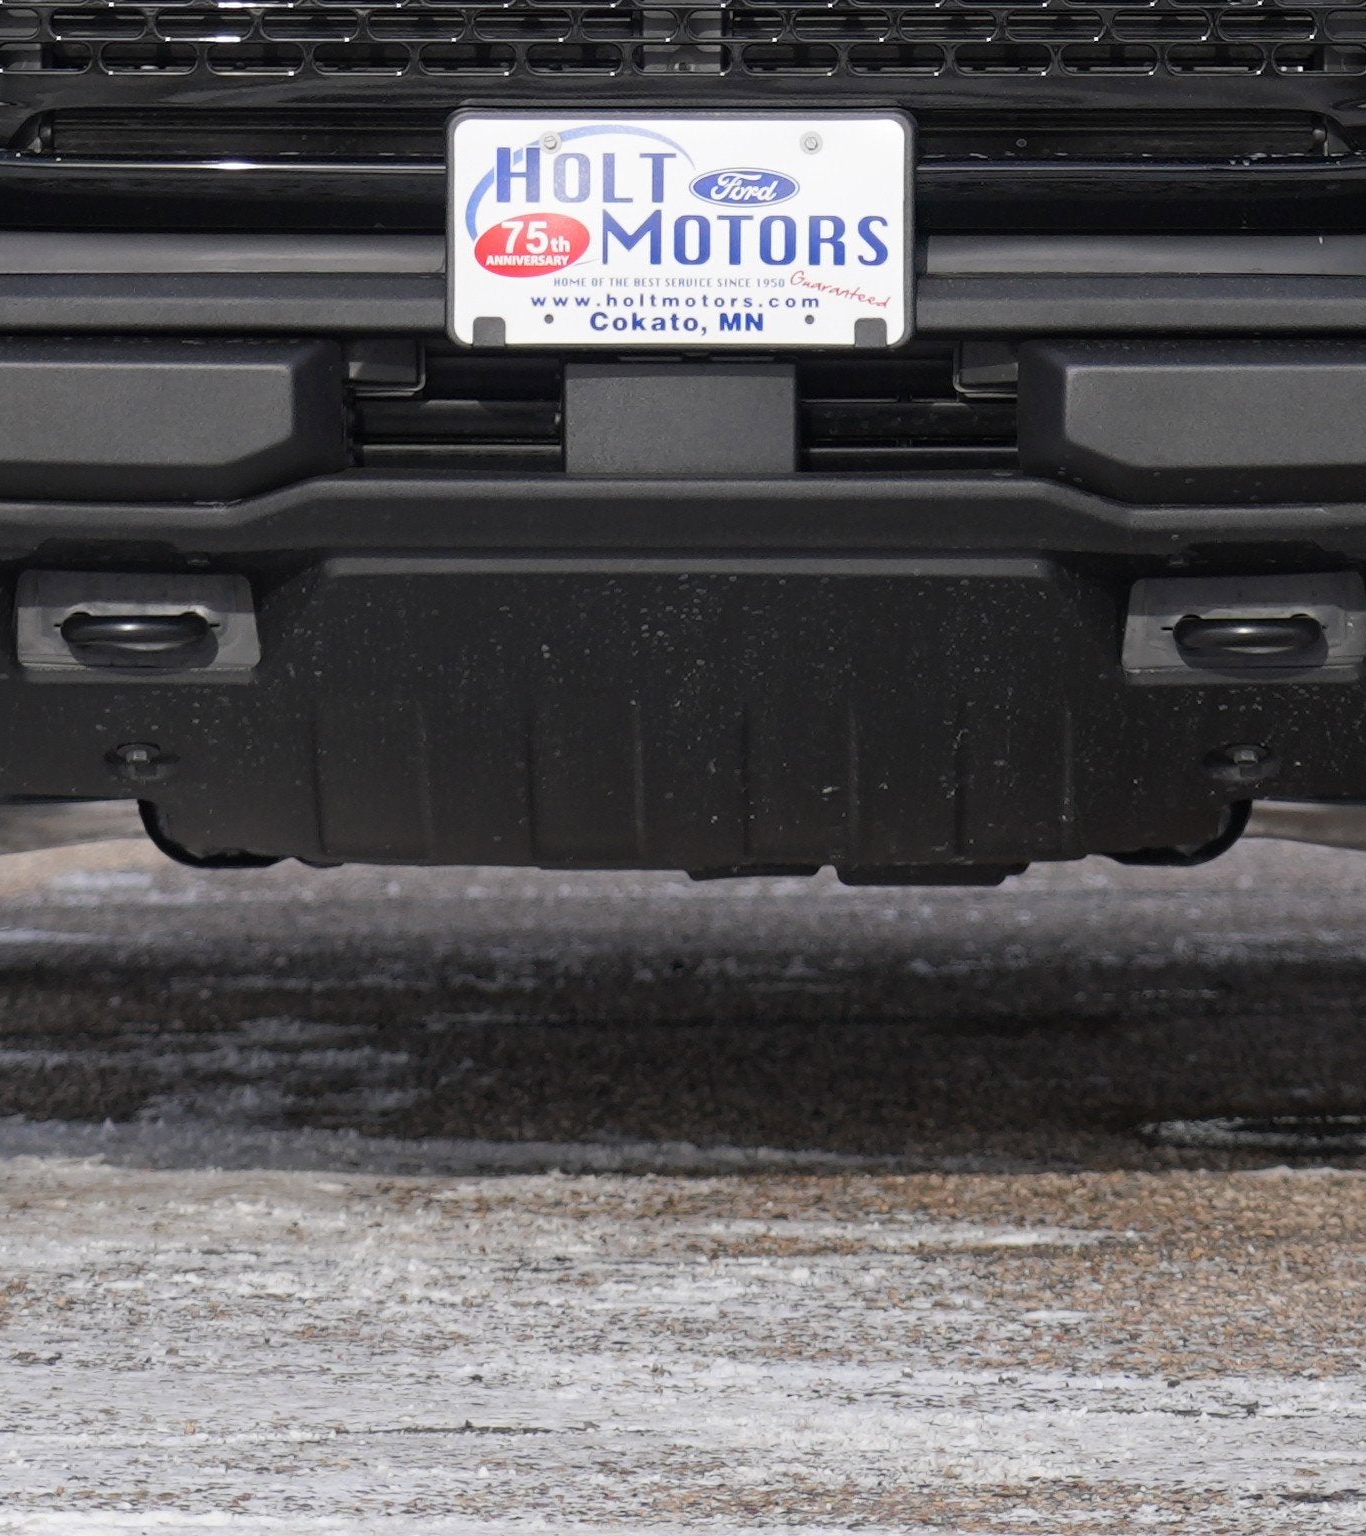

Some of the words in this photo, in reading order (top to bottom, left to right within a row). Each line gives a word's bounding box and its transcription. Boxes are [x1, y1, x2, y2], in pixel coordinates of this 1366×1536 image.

[496, 147, 677, 204] HOLT
[710, 171, 780, 202] Ford
[501, 220, 571, 255] 75th
[601, 209, 889, 266] MOTORS
[485, 254, 570, 267] ANNIVERSARY
[553, 277, 587, 288] HOME
[591, 277, 604, 288] OF
[609, 277, 630, 288] THE
[634, 278, 661, 288] BEST
[665, 278, 713, 288] SERVICE
[717, 278, 751, 288] SINCE
[756, 278, 786, 289] 1950
[790, 270, 892, 308] Guaranteed
[531, 293, 820, 309] www.holtmotors.com
[589, 311, 707, 336] Cokato,
[719, 312, 764, 332] MN
